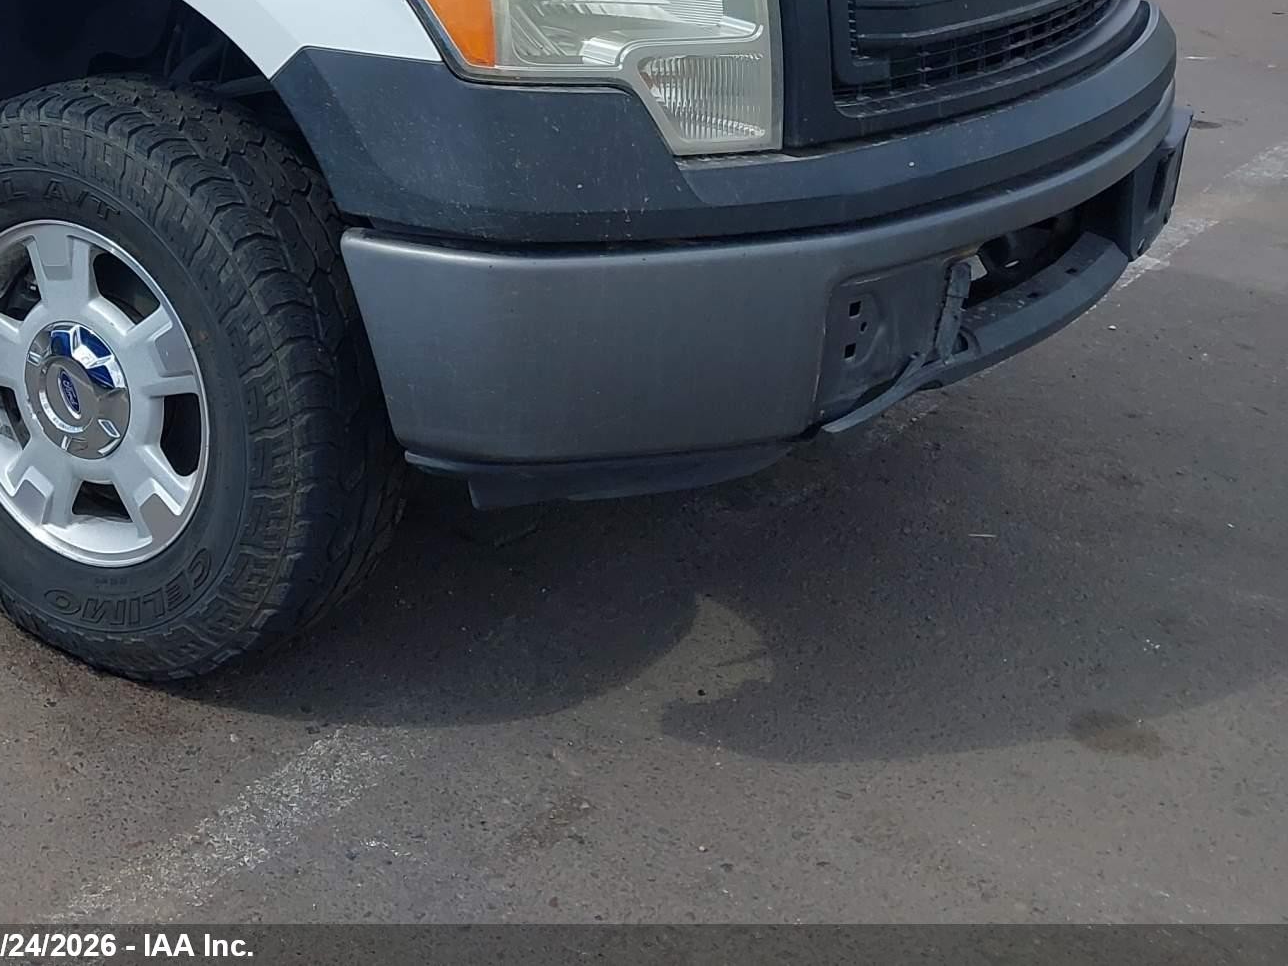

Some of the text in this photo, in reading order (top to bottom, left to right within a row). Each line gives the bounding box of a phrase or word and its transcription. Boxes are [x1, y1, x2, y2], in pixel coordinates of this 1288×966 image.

[42, 177, 122, 221] A/T
[62, 379, 79, 407] Ford
[43, 547, 213, 627] CELIMO
